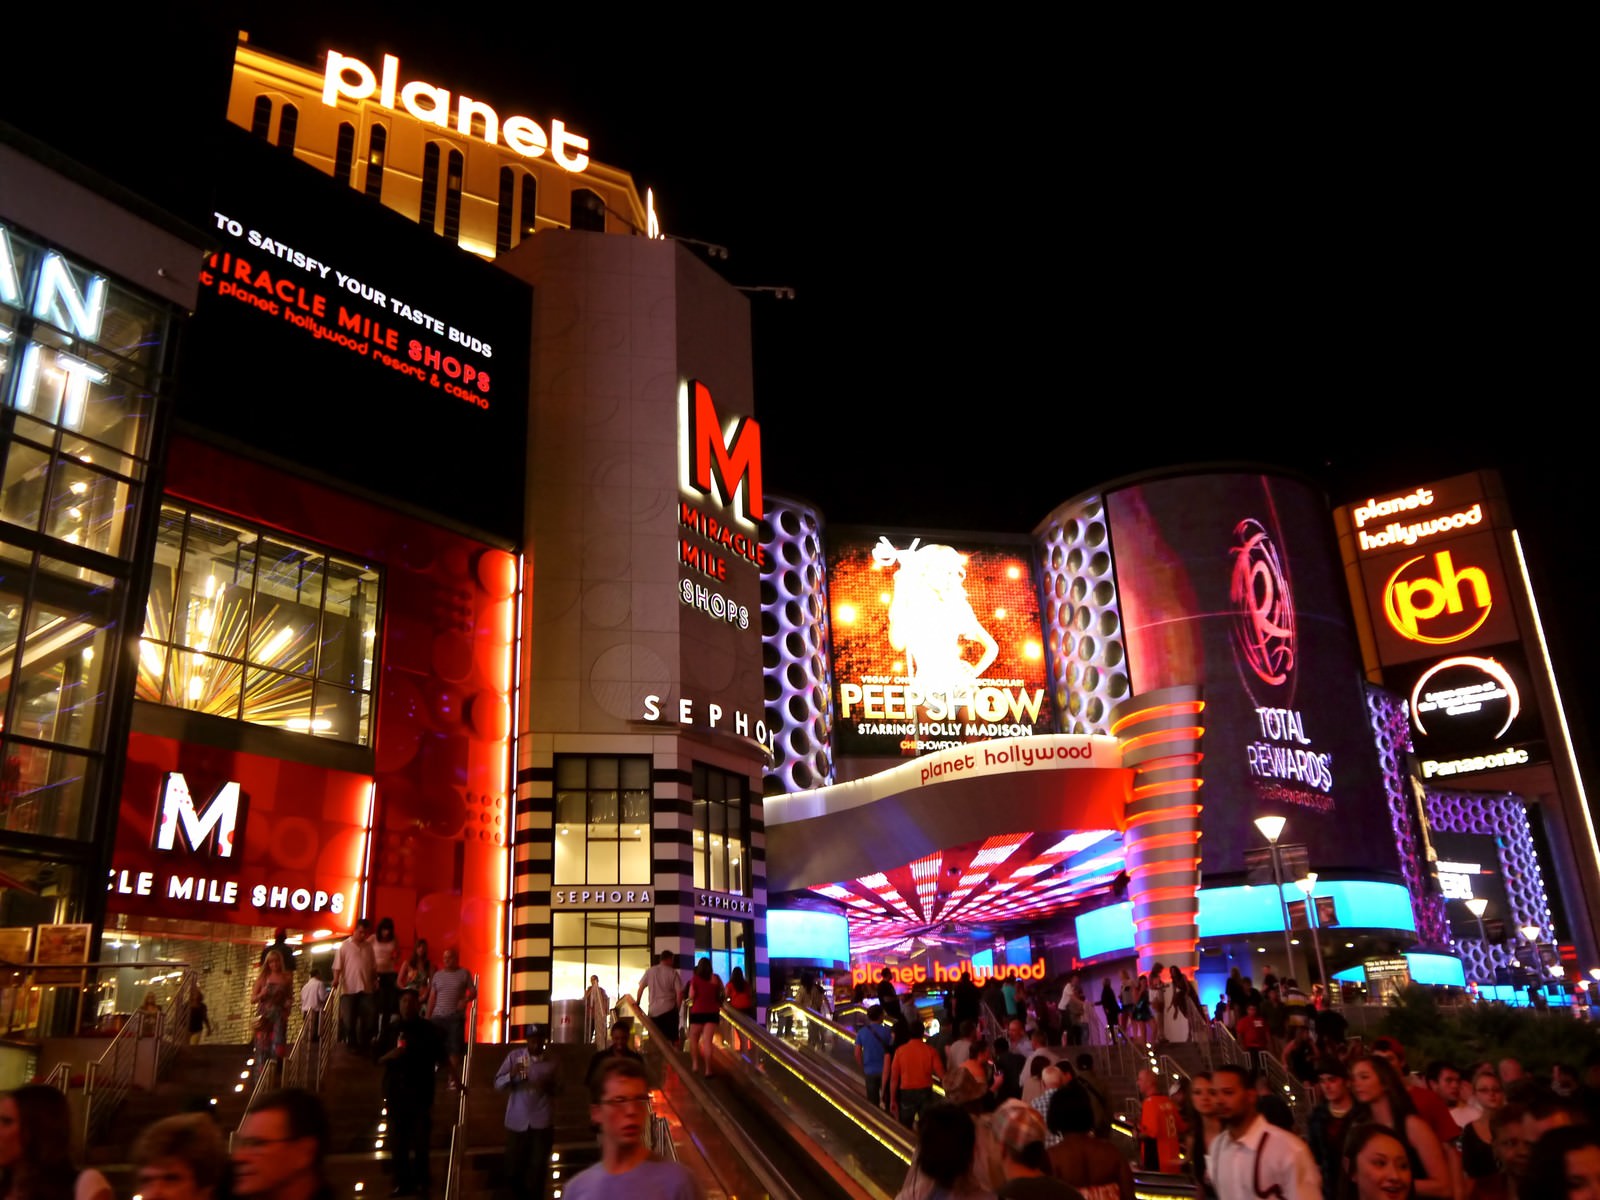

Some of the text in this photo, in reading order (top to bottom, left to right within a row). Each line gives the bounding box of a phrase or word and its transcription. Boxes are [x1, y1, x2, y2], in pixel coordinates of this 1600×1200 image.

[322, 49, 590, 173] planet
[213, 211, 493, 358] TO SATISFY YOUR TASTE BUDS
[218, 280, 279, 316] planet
[284, 306, 369, 356] hollywood
[372, 350, 427, 381] resort
[430, 373, 440, 388] &
[444, 382, 490, 410] casino
[338, 306, 399, 351] MILE
[408, 339, 491, 393] SHOPS
[686, 377, 764, 523] M
[1353, 487, 1434, 528] planet
[1358, 504, 1483, 551] hollywood
[680, 501, 766, 567] MIRACLE
[680, 539, 726, 581] MILE
[681, 578, 749, 630] SHOPS
[1394, 550, 1492, 637] ph
[840, 683, 1045, 724] PEEPSHOW
[1255, 707, 1311, 744] TOTAL
[857, 722, 1033, 737] STARRING HOLLY MADISON
[920, 742, 1093, 785] planet hollywood
[1421, 747, 1529, 778] Panasonic
[155, 771, 241, 858] M
[168, 875, 238, 904] MILE
[251, 884, 345, 914] SHOPS
[556, 890, 650, 904] SEPHORA
[700, 893, 753, 913] SEPHORA
